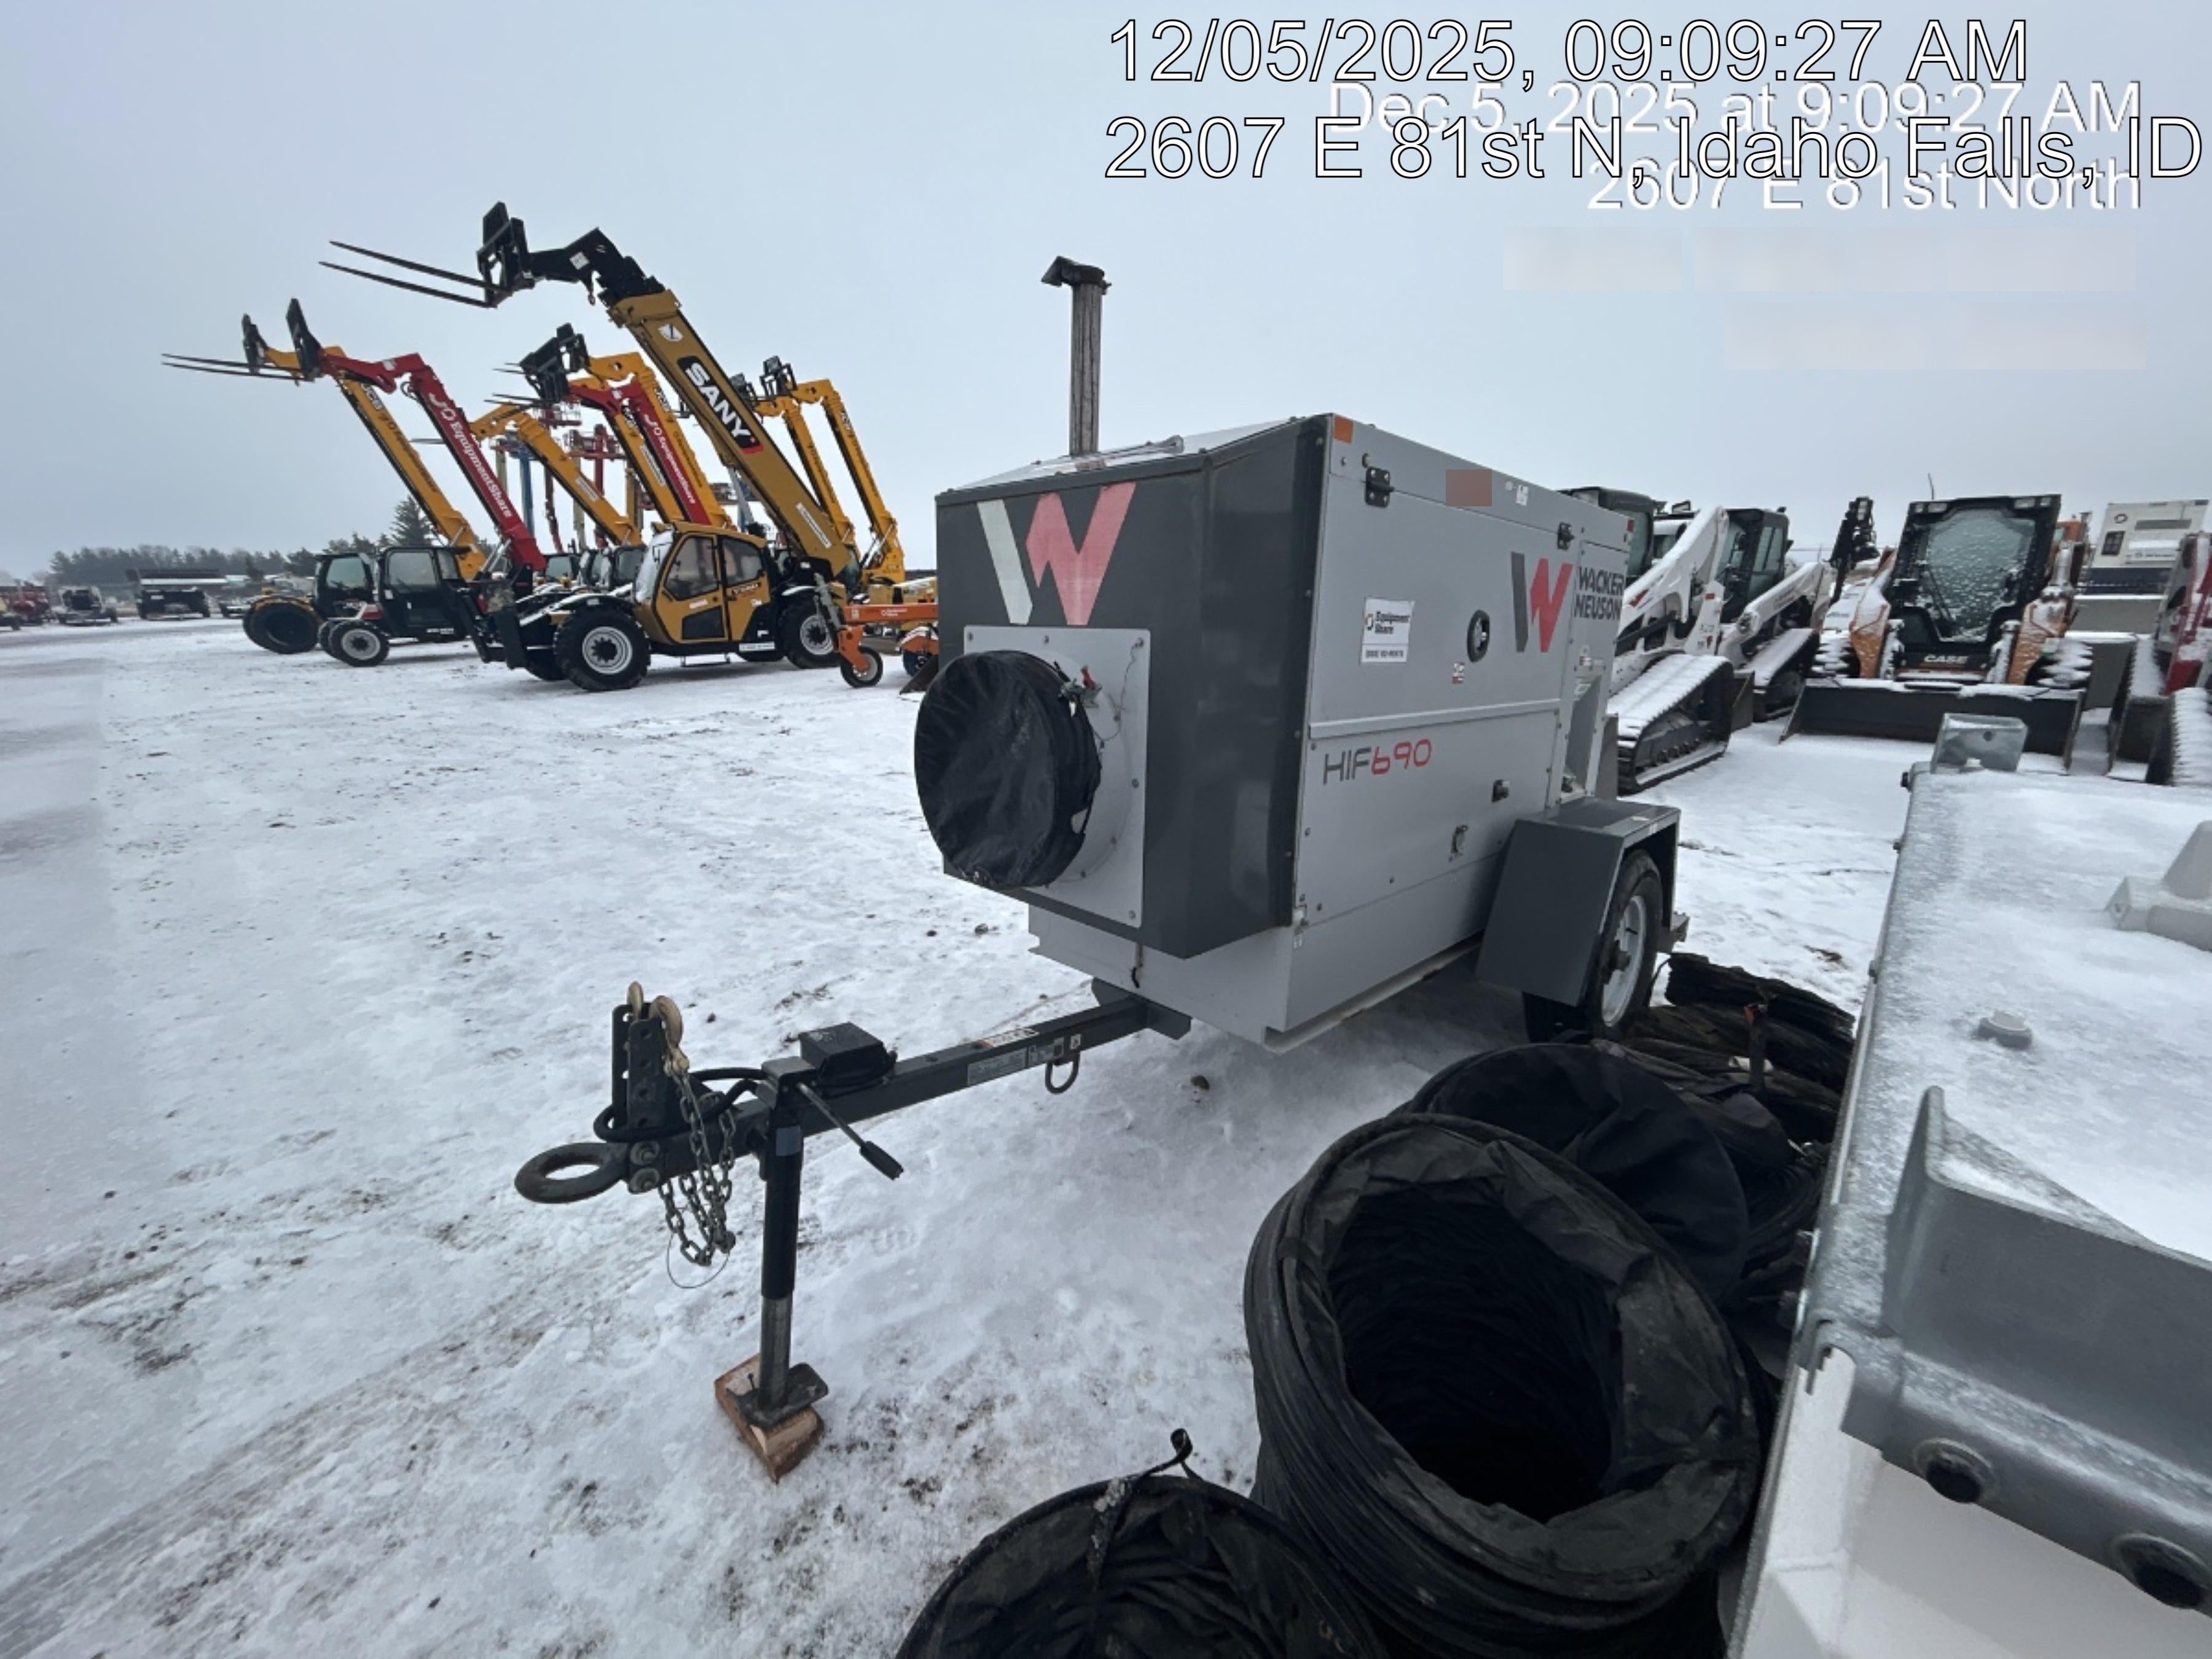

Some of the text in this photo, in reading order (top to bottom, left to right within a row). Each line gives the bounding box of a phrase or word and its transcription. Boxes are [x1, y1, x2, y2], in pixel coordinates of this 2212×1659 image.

[685, 363, 751, 437] SANY
[450, 422, 512, 517] EquipmentShare
[1579, 566, 1625, 595] WACKER
[1574, 594, 1622, 621] NEUSON
[1924, 654, 1969, 664] CASE
[1323, 739, 1432, 785] HIF690
